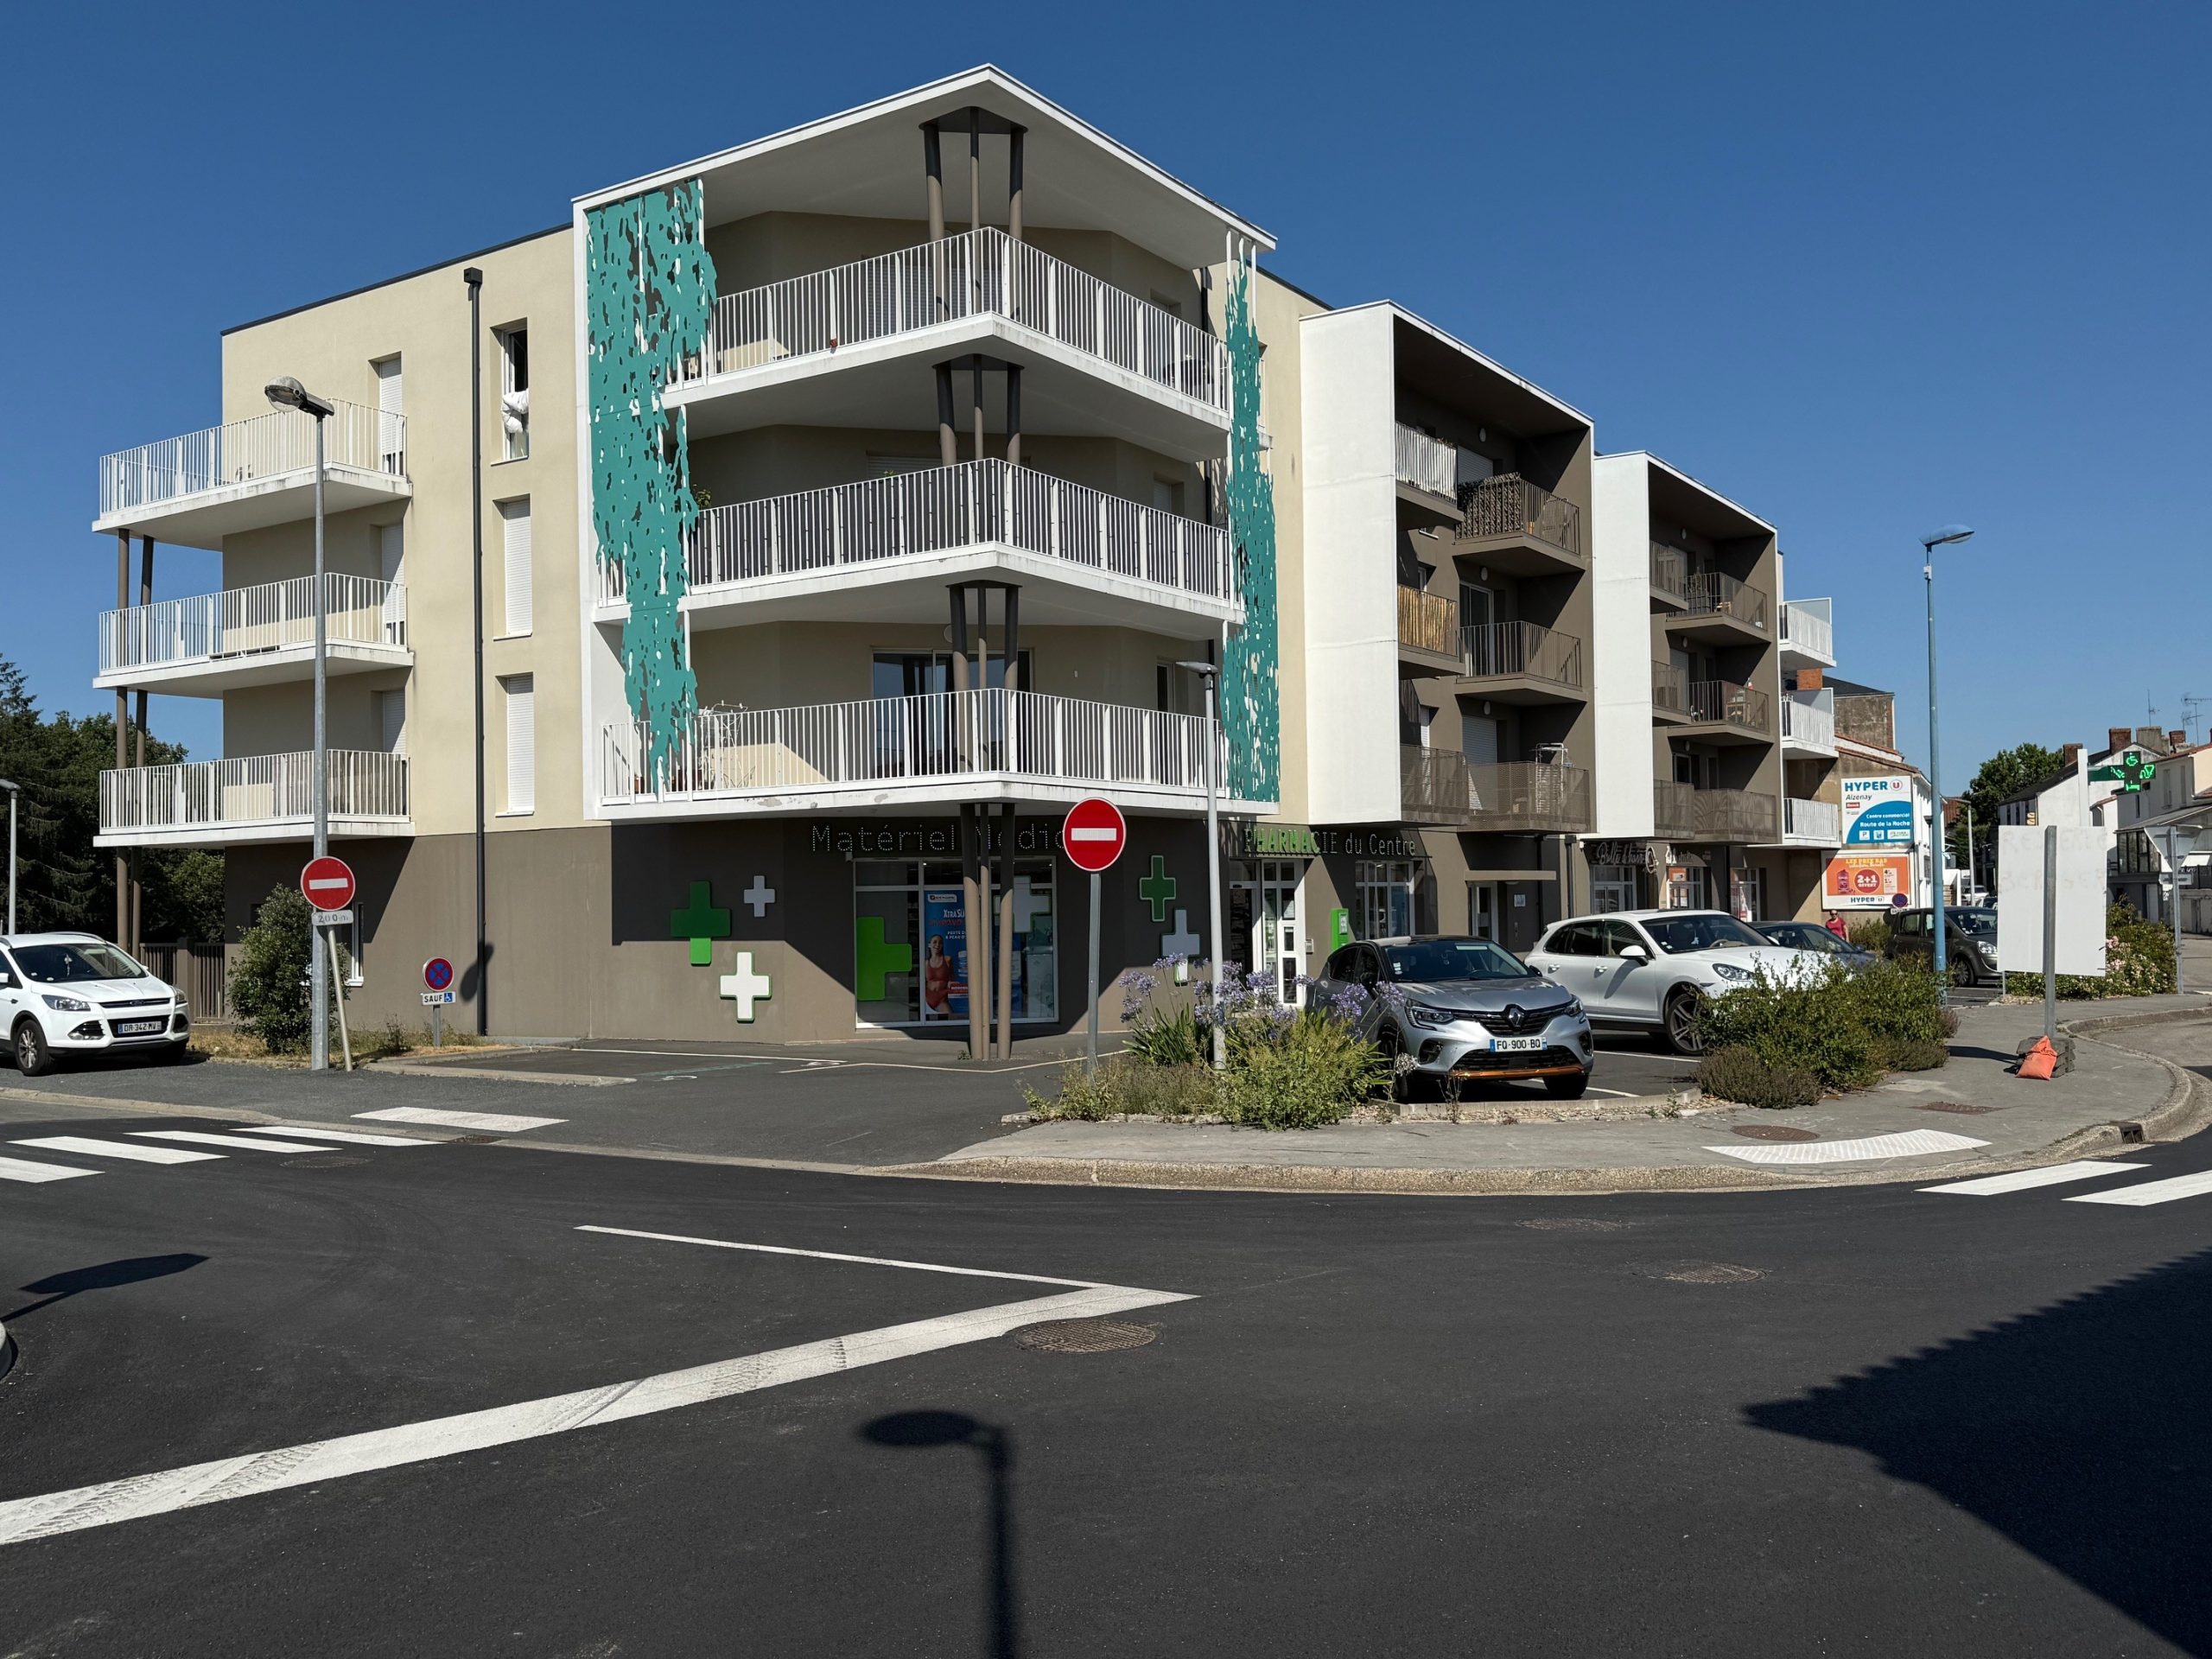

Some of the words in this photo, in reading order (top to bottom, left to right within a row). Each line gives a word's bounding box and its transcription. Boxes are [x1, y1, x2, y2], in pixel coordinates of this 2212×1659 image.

[1845, 781, 1888, 791] HYPER
[812, 823, 954, 851] Matériel
[1244, 828, 1338, 854] PHARMACIE
[1344, 832, 1362, 855] du
[1369, 833, 1415, 856] Centre
